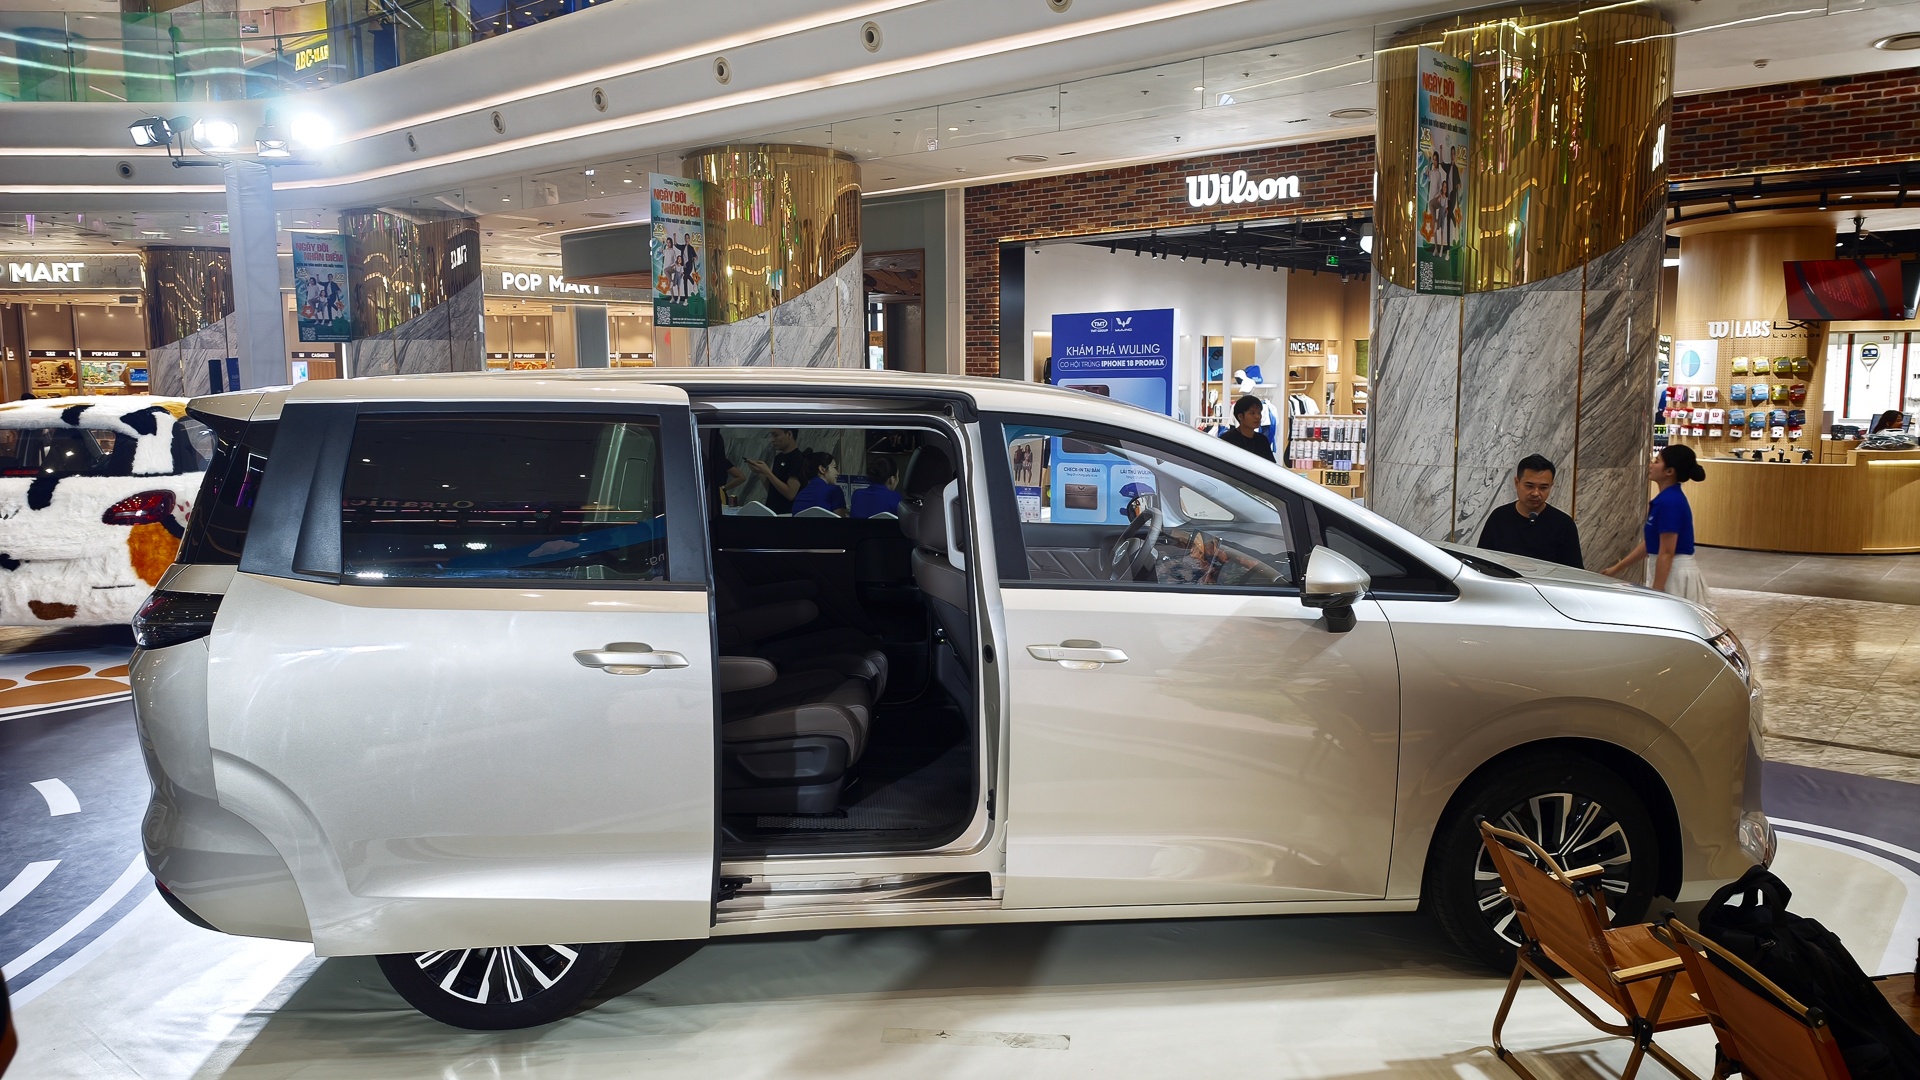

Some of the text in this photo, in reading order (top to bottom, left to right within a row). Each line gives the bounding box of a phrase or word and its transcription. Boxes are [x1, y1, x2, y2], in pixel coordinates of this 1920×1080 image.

[653, 188, 673, 202] NGÀY
[1186, 170, 1301, 207] Wilson
[661, 202, 682, 216] NHÂN
[8, 262, 85, 283] MART
[501, 272, 543, 292] POP
[1735, 320, 1771, 338] LABS
[1066, 342, 1161, 356] KHÁM PHÁ WULING
[1101, 360, 1126, 368] IPHONE
[1135, 359, 1165, 367] PROMAX
